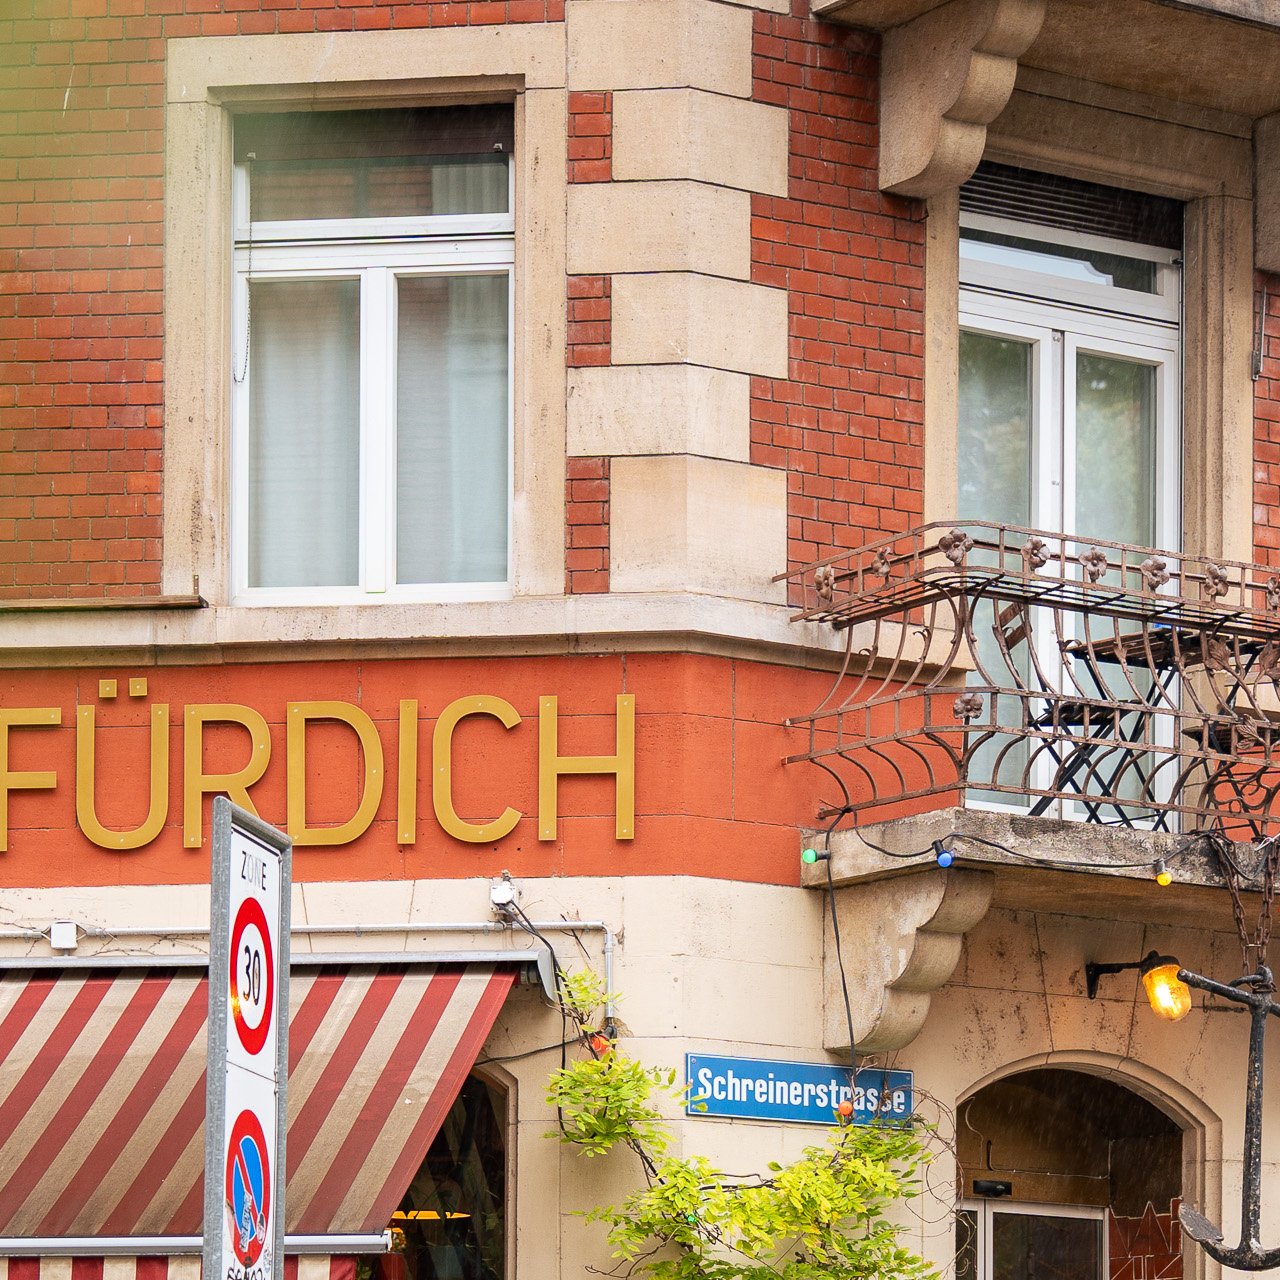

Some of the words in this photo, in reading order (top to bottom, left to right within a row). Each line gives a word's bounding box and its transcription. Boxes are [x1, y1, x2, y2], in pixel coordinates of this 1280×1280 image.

[240, 850, 267, 892] ZONE
[242, 944, 262, 1007] 30
[696, 1066, 906, 1114] Schreinerstrasse
